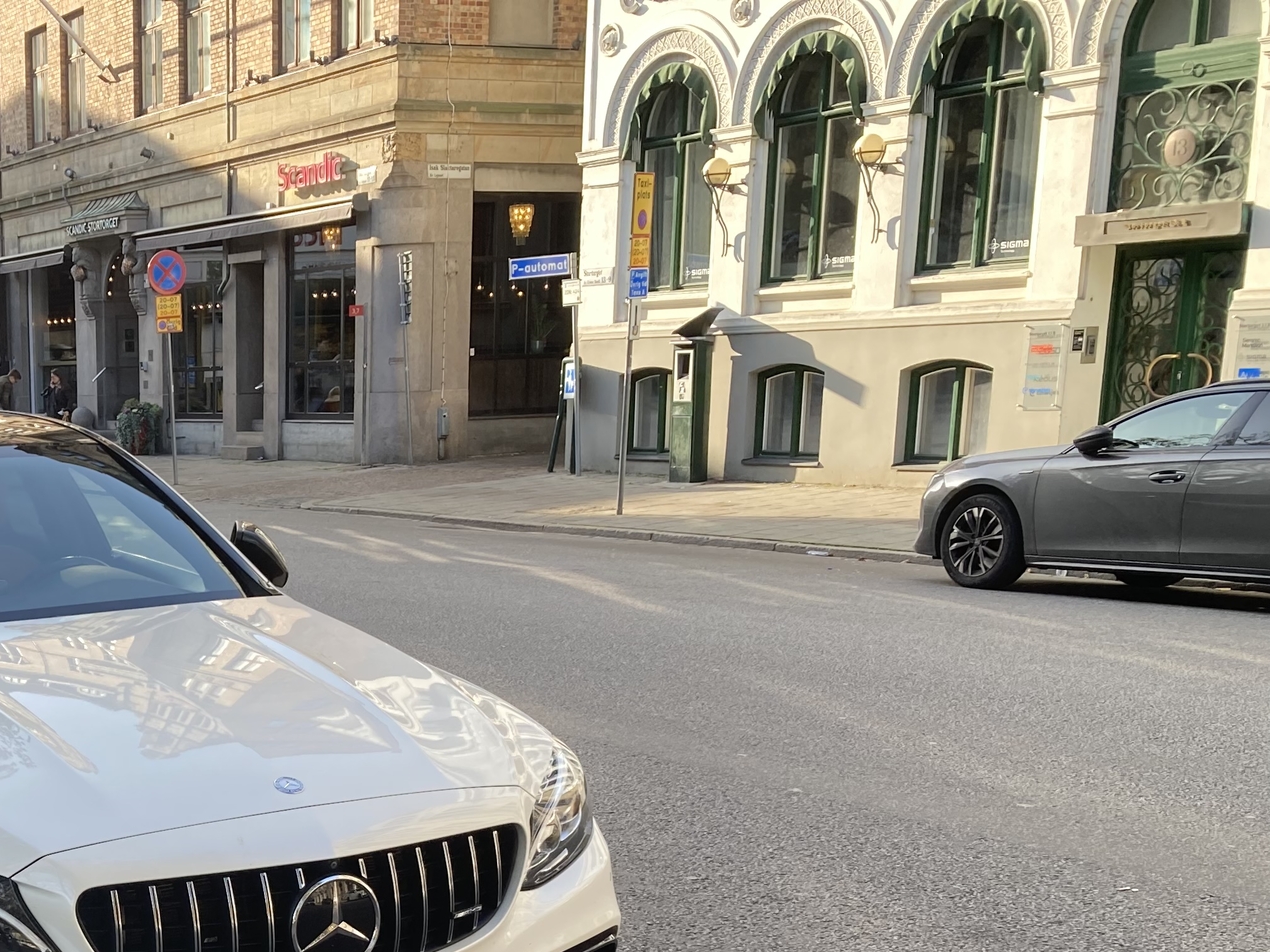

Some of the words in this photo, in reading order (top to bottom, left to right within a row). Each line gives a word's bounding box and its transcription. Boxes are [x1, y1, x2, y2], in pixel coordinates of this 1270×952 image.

[1172, 139, 1188, 156] 13
[277, 151, 342, 192] Scandic
[511, 258, 568, 275] P-automat
